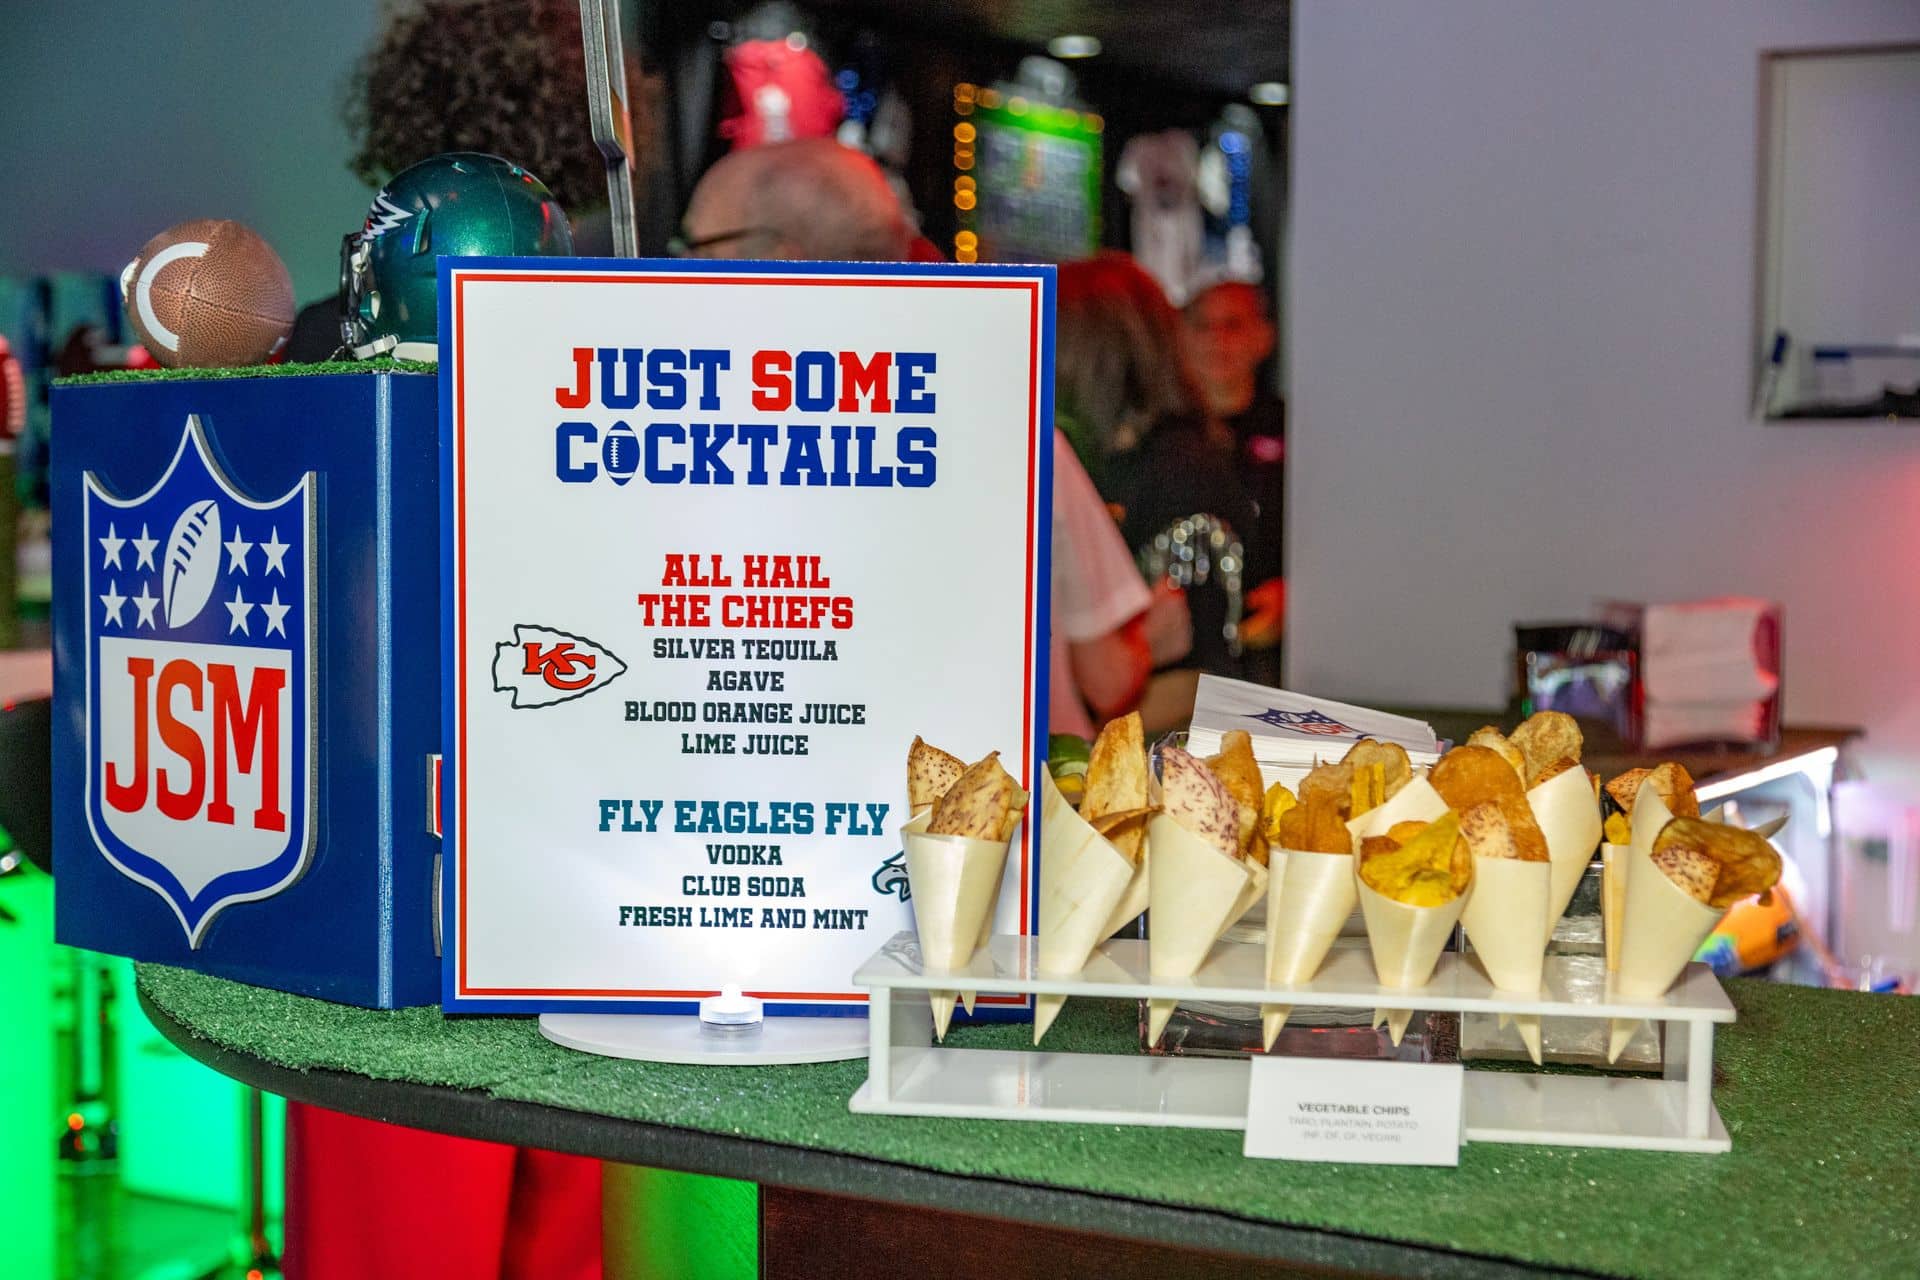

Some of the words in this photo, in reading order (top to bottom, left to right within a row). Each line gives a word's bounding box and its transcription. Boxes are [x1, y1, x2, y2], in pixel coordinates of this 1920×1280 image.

[555, 347, 731, 412] JUST
[751, 350, 937, 415] SOME
[662, 554, 733, 588] ALL
[743, 554, 831, 590] HAIL
[638, 594, 711, 628] THE
[721, 595, 854, 630] CHIEFS
[652, 637, 736, 660] SILVER
[741, 639, 839, 662] TEQUILA
[521, 642, 597, 691] KC
[705, 669, 785, 693] AGAVE
[623, 700, 697, 723] BLOOD
[702, 701, 793, 724] ORANGE
[798, 703, 866, 726] JUICE
[104, 656, 287, 834] JSM
[680, 732, 737, 755] LIME
[741, 733, 809, 756] JUICE
[598, 799, 665, 833] FLY
[673, 799, 815, 836] EAGLES
[824, 801, 890, 837] FLY
[705, 843, 783, 866] VODKA
[681, 875, 741, 897] CLUB
[746, 875, 806, 898] SODA
[618, 905, 693, 928] FRESH
[699, 906, 754, 928] LIME
[759, 907, 807, 929] AND
[812, 909, 869, 931] MINT
[1297, 1102, 1369, 1115] VEGETABLE
[1372, 1105, 1411, 1116] CHIPS
